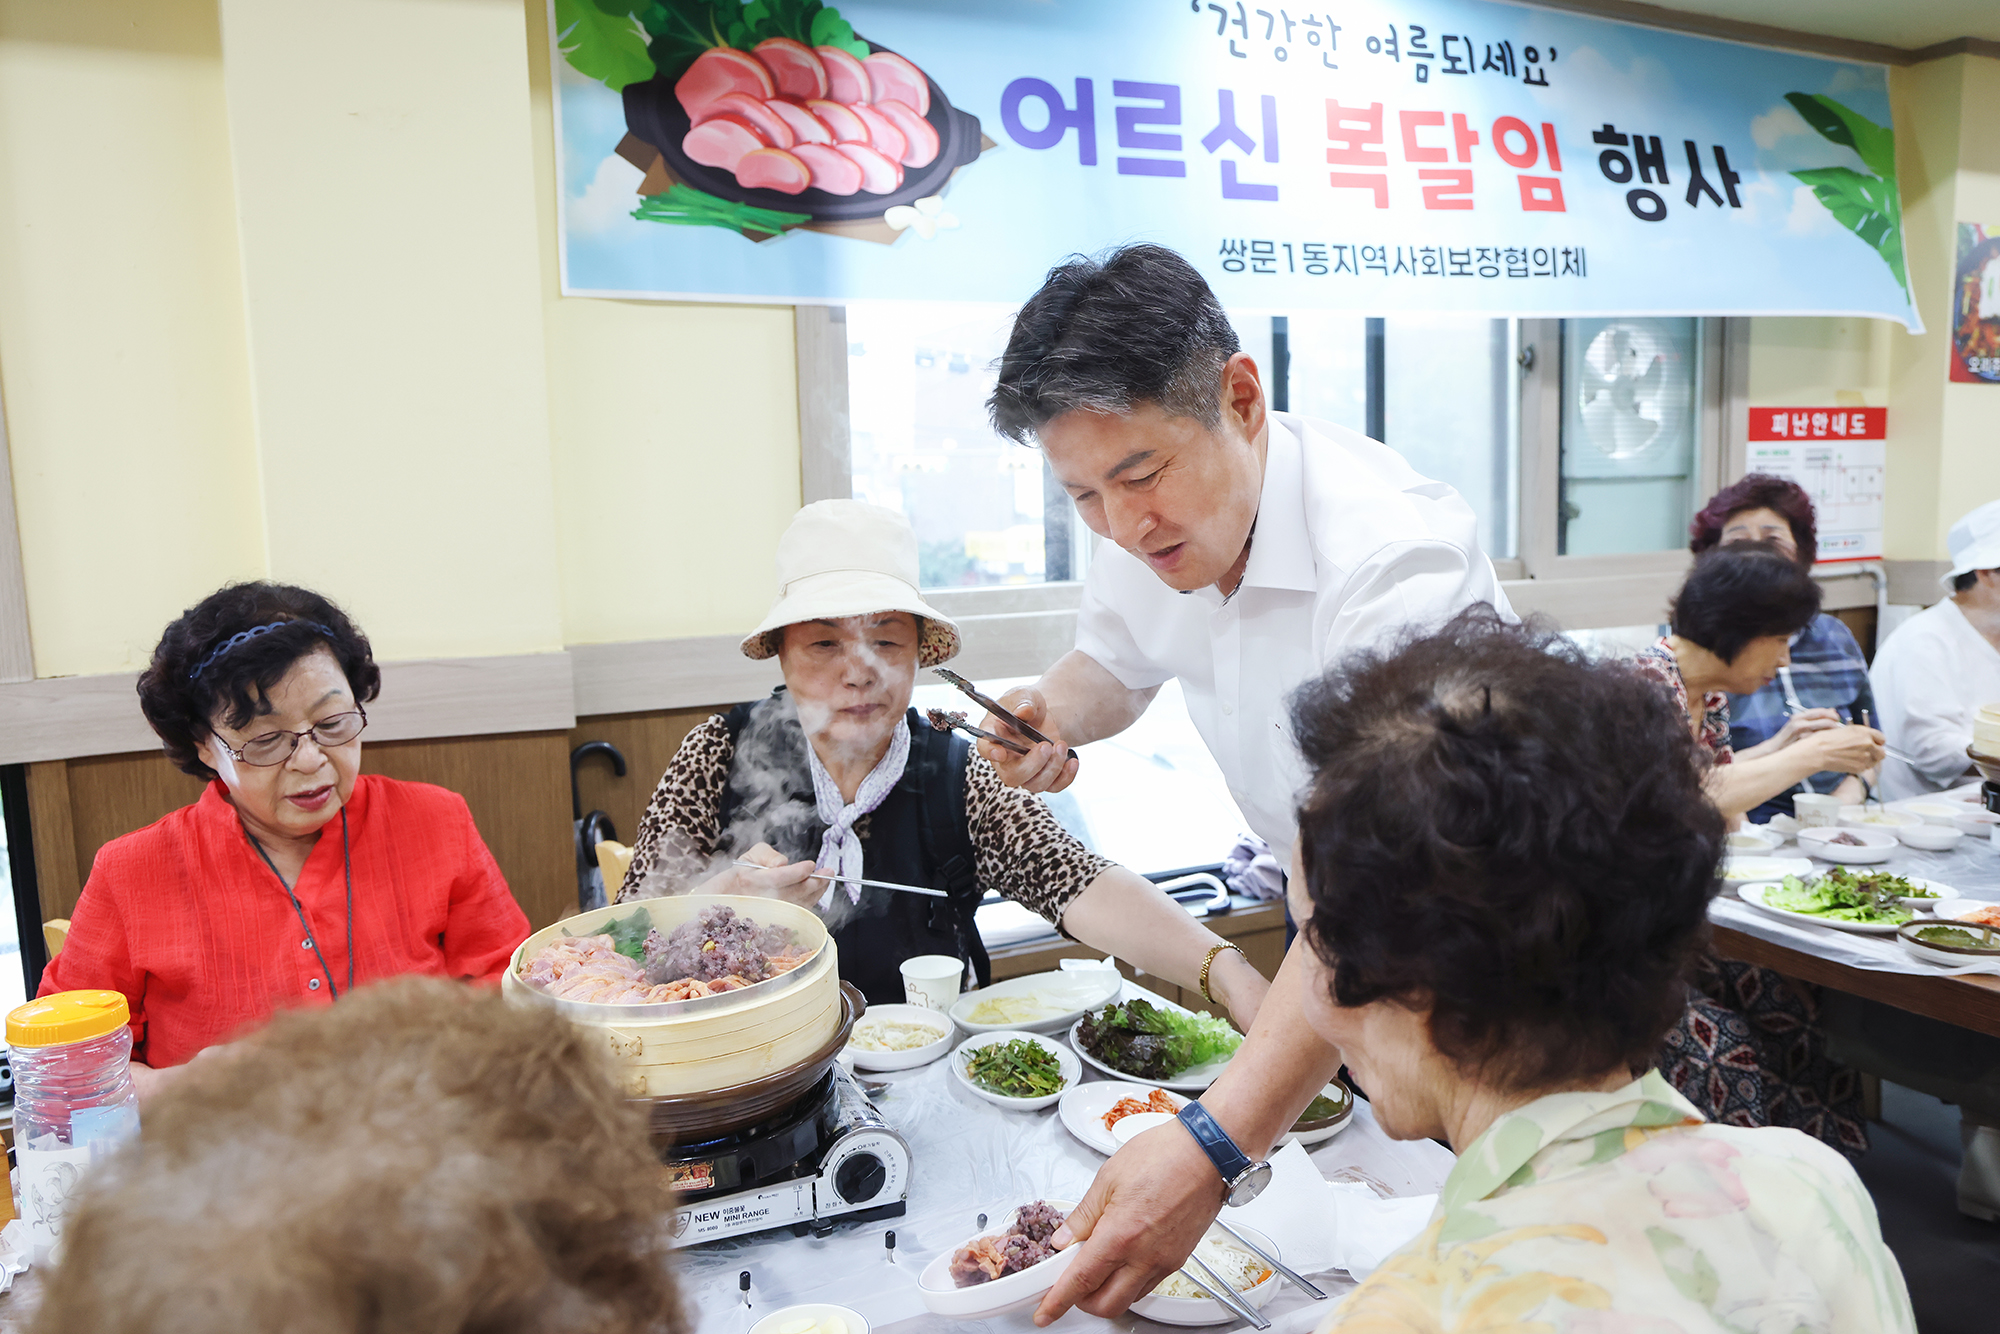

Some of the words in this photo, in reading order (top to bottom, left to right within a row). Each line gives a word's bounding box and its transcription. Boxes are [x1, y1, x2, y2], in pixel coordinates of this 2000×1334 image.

[1366, 24, 1558, 87] 여름되세요'
[1000, 77, 1280, 202] 어르신
[1325, 98, 1567, 213] 복달임
[1592, 123, 1742, 222] 행사
[1219, 239, 1588, 278] 쌍문1동지역사회보장협의체
[1770, 412, 1867, 437] 피난안내도
[694, 1210, 721, 1223] NEW
[724, 1212, 741, 1223] MINI
[742, 1208, 771, 1219] RANGE
